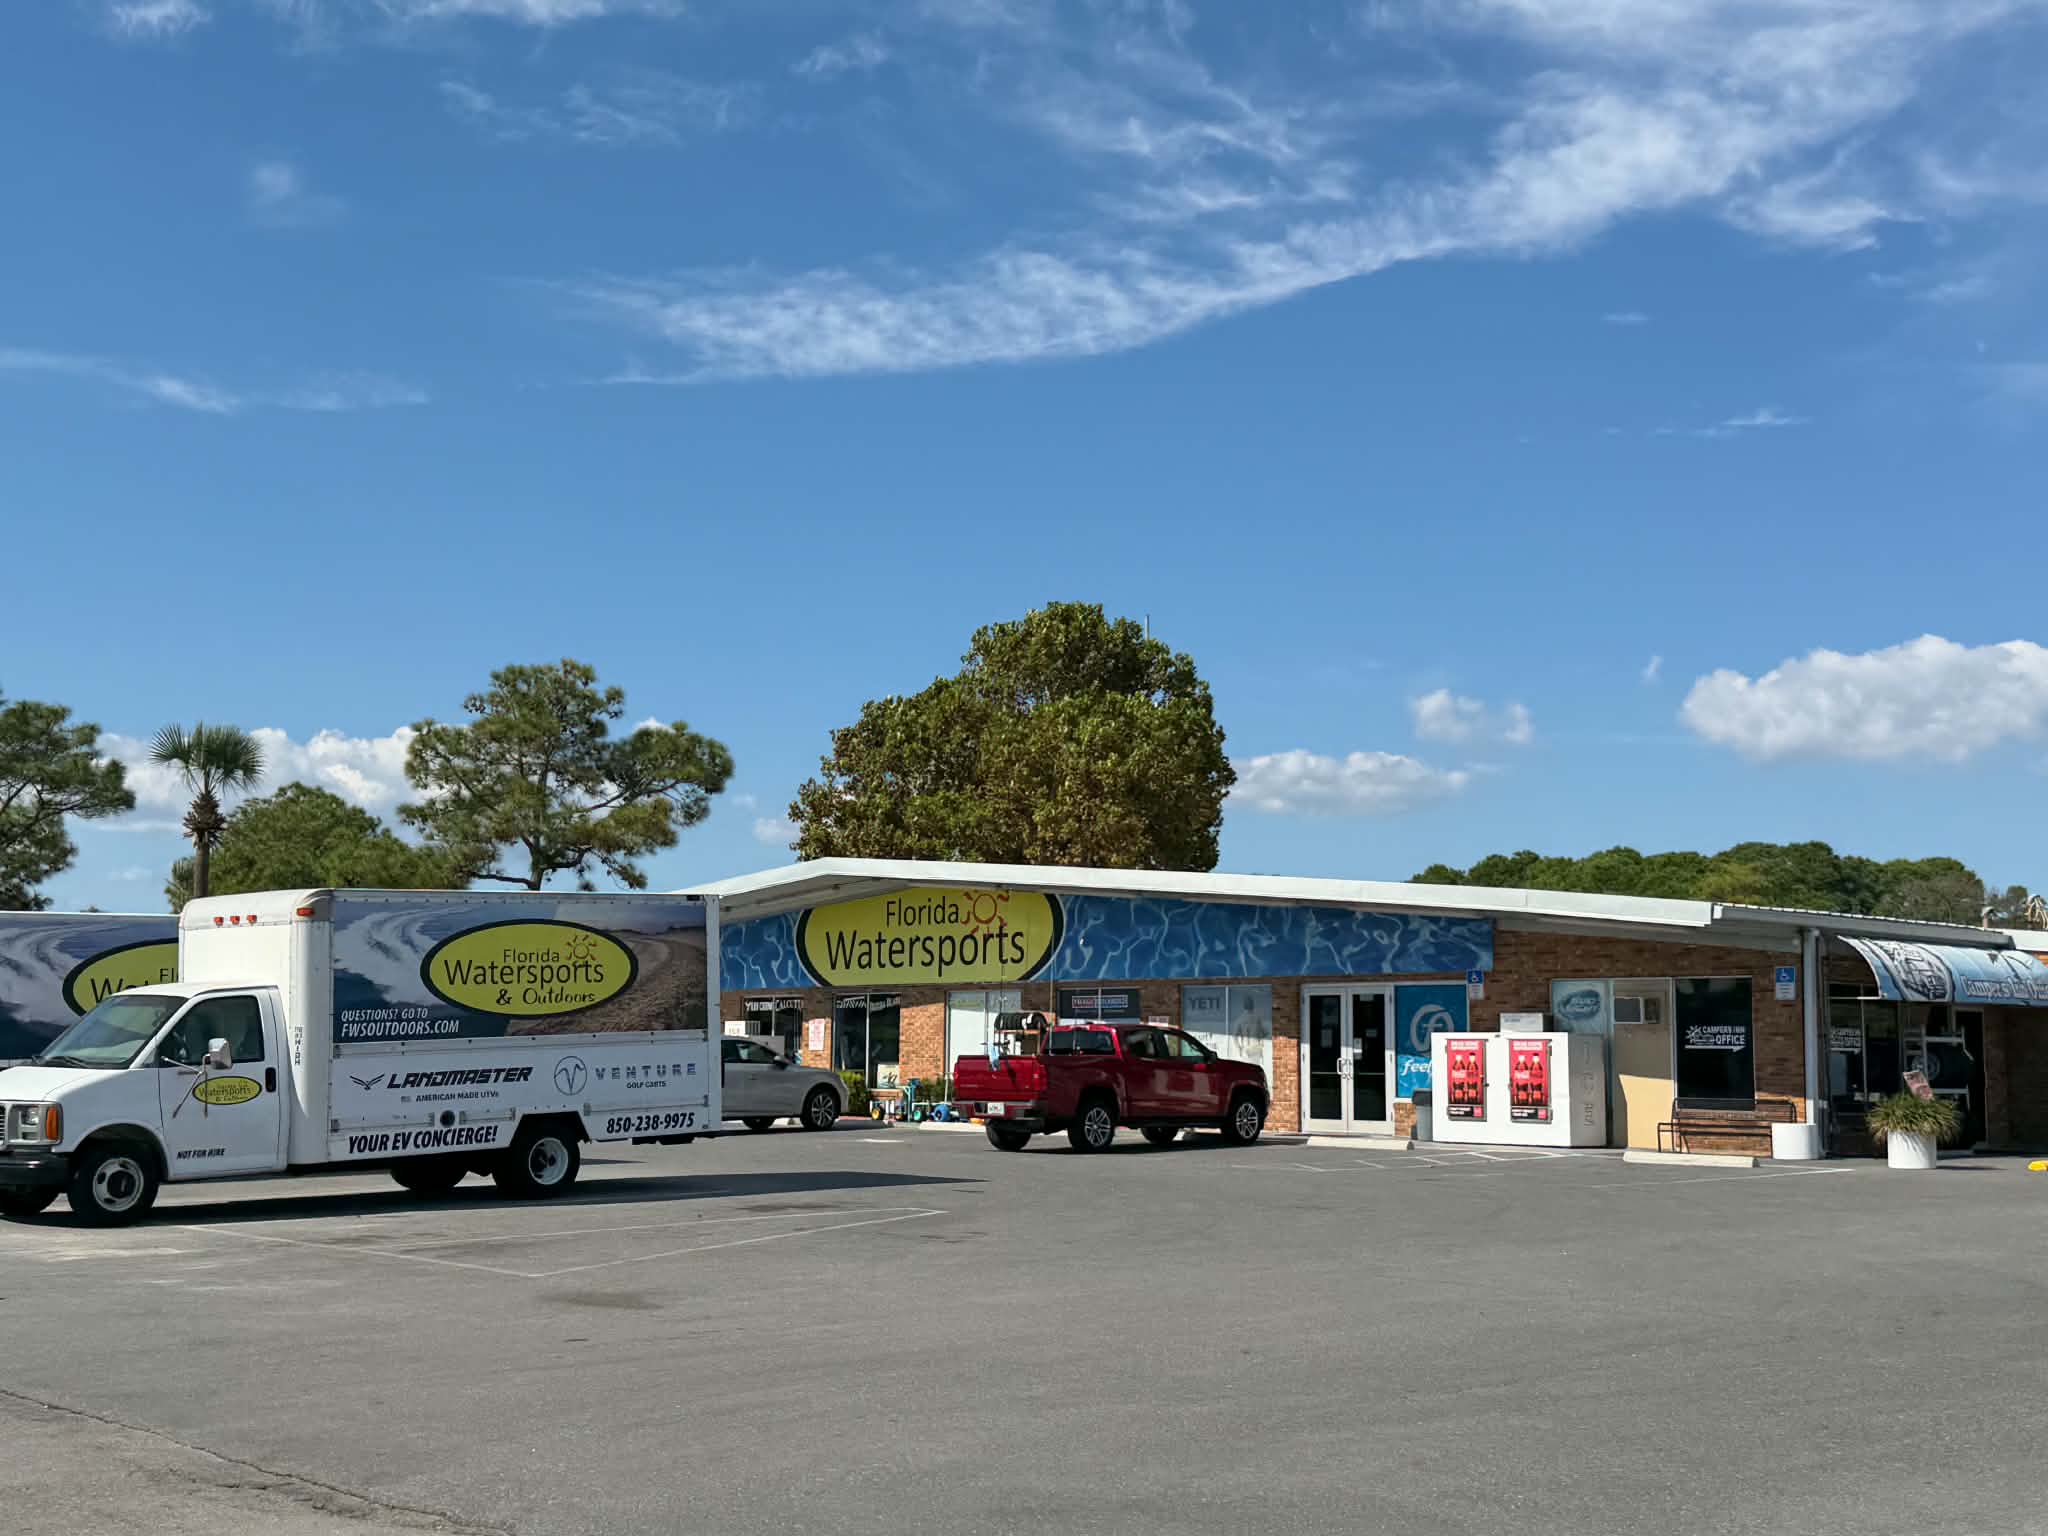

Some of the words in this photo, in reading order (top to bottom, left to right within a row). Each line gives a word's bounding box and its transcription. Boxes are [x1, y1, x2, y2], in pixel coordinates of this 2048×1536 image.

[886, 896, 960, 927] Florida
[503, 948, 560, 963] Florida
[825, 927, 1025, 977] Watersports
[444, 958, 604, 990] Watersports
[496, 988, 513, 1005] &
[523, 986, 596, 1005] Outdoors
[1188, 997, 1220, 1009] YETI
[341, 1008, 399, 1021] QUESTIONS?
[402, 1008, 415, 1019] GO
[416, 1007, 429, 1018] TO
[341, 1019, 460, 1037] FWSOUTDOORS.COM
[1716, 1034, 1745, 1045] OFFICE
[387, 1067, 534, 1089] LANDMASTER
[595, 1063, 697, 1080] VENTURE
[626, 1081, 643, 1089] GOLF
[415, 1092, 456, 1102] AMERICAN
[457, 1091, 479, 1100] MADE
[606, 1112, 695, 1134] 850-238-9975
[349, 1133, 390, 1154] YOUR
[392, 1131, 412, 1150] EV
[413, 1125, 499, 1149] CONCIERGE!
[176, 1150, 192, 1160] NOT
[192, 1149, 207, 1158] FOR
[207, 1148, 225, 1157] HIRE
